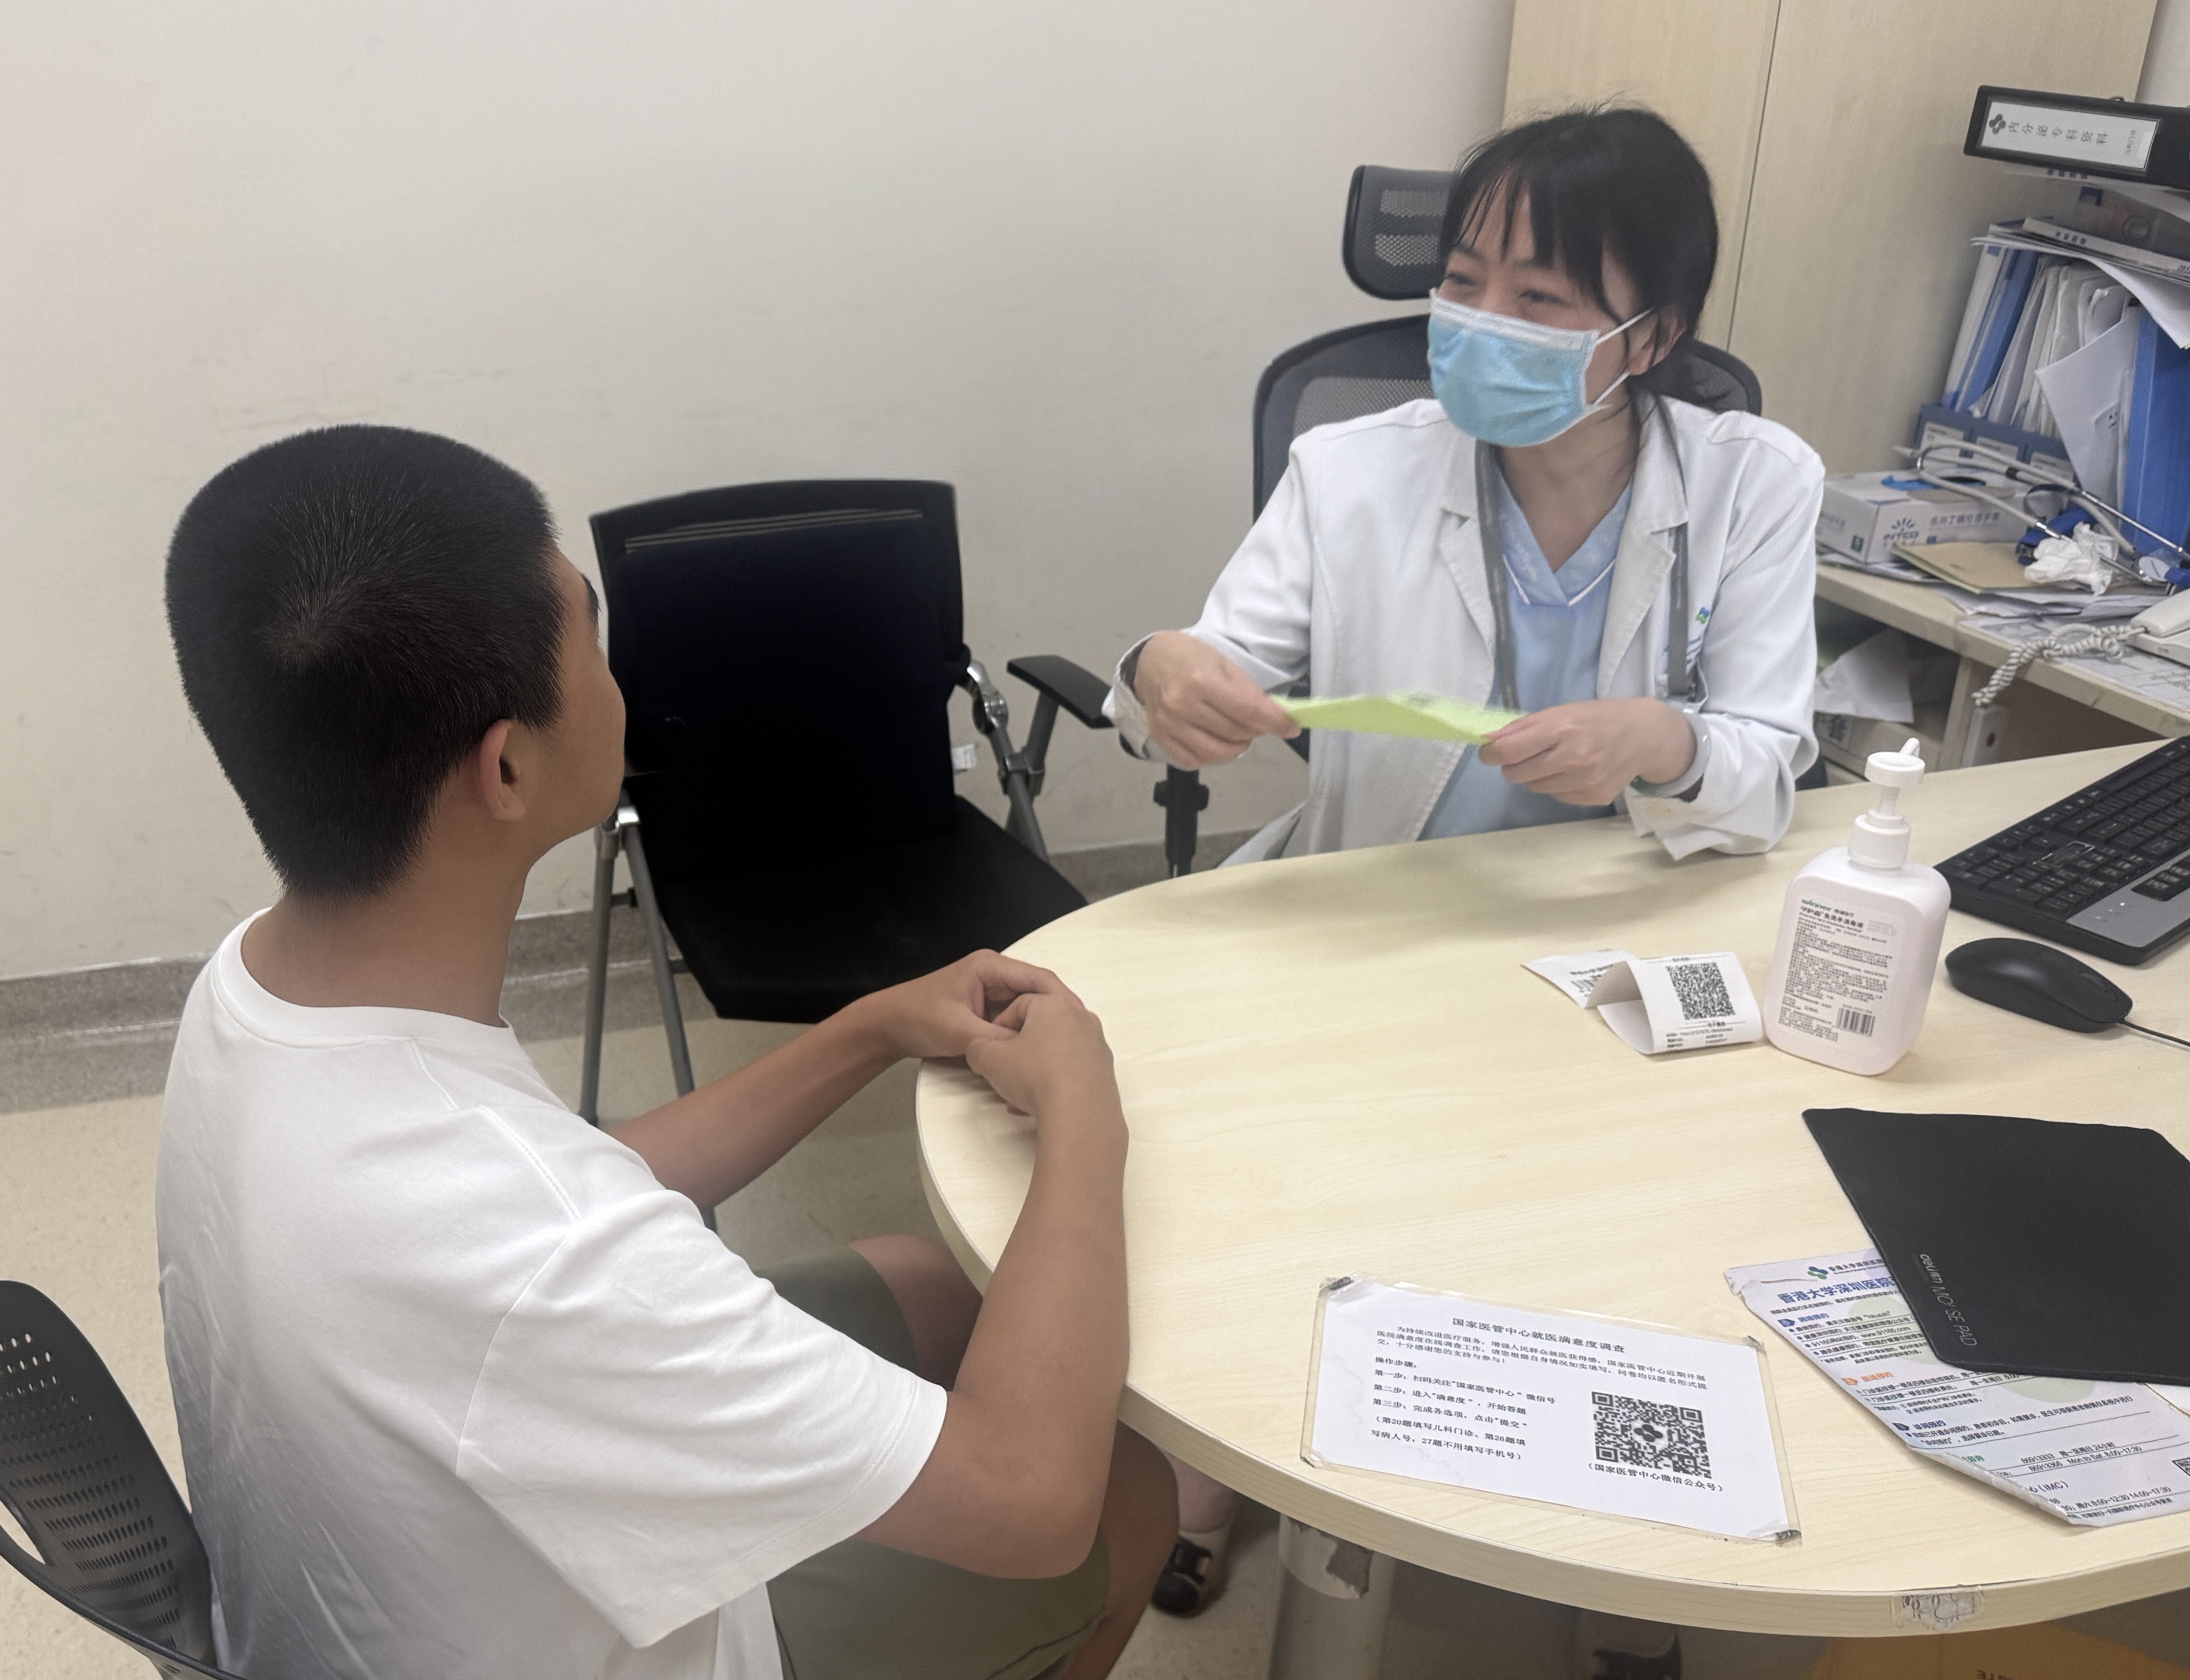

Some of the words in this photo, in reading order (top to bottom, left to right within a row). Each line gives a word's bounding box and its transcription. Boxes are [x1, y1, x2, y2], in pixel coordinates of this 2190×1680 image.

[1777, 1276, 1895, 1304] 香港大学深圳医院
[1453, 1318, 1625, 1353] 国家医管中心就医满意度调查
[1953, 1325, 1977, 1346] PAD
[1588, 1463, 1723, 1492] （国家医管中心微信公众号）
